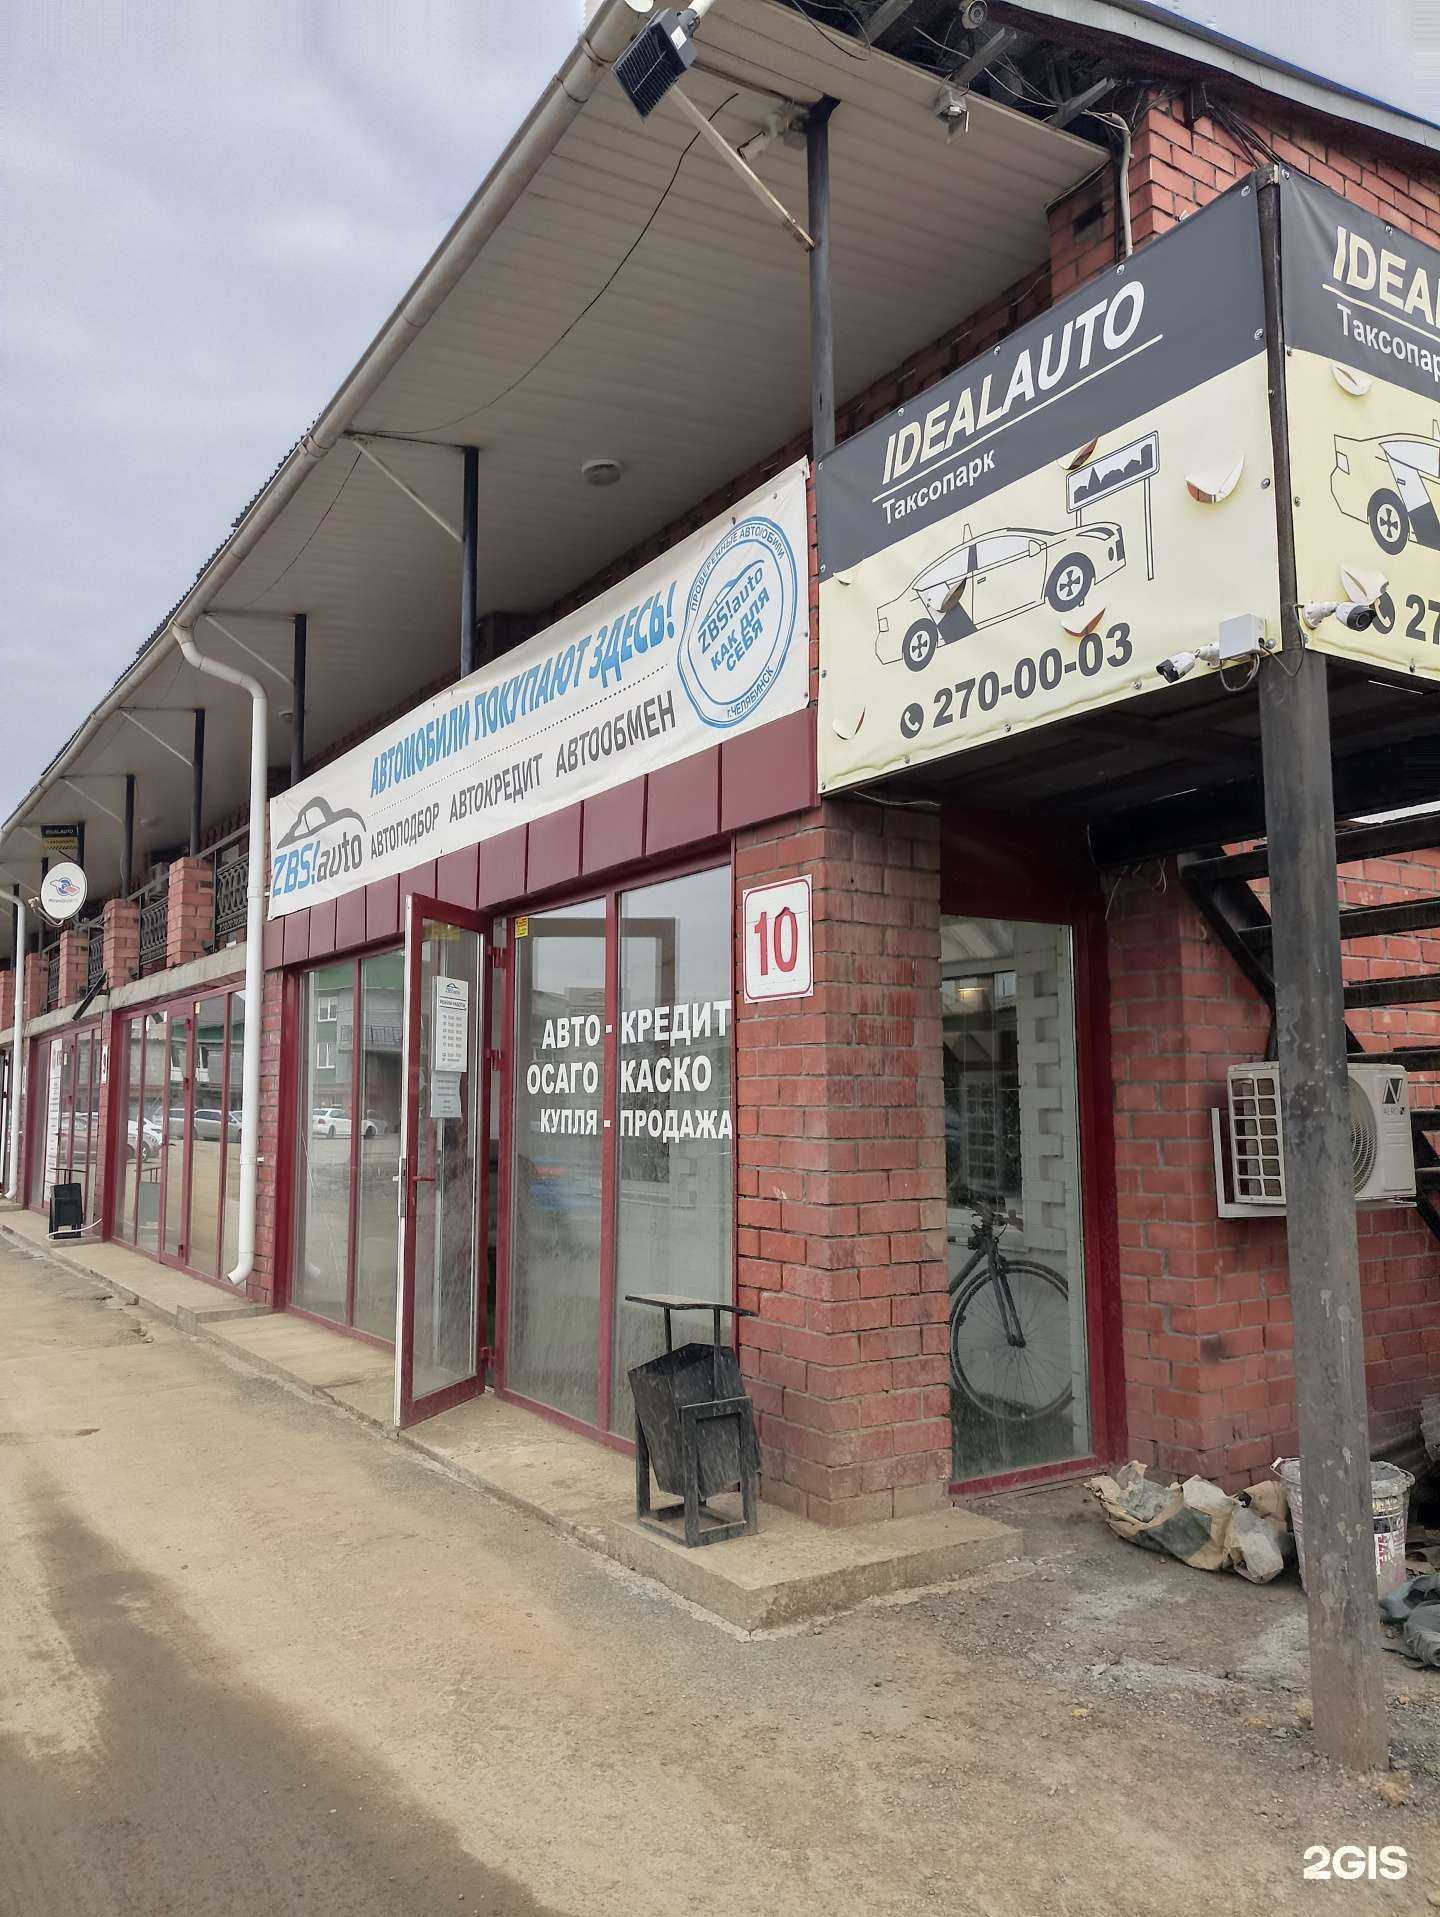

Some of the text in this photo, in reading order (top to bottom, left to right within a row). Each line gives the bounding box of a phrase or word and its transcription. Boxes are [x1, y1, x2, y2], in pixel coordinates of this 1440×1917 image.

[1332, 225, 1440, 329] IDEA
[882, 280, 1145, 485] IDEALAUTO
[882, 449, 997, 524] Таксопарк
[739, 525, 784, 560] АВТООБИЛИ
[697, 566, 764, 655] ZBS!auto
[726, 617, 764, 672] СЕБЯ
[710, 629, 739, 672] КАК
[932, 622, 1133, 728] 270-00-03
[370, 580, 678, 798] АВТОМОБИЛИ ПОКУПАЮТ ЗДЕСЬ!
[370, 690, 676, 860] АВТОПОДБОР АВТОКРЕДИТ АВТООБМЕН
[272, 831, 363, 897] ZBS!auto
[753, 906, 799, 977] 10
[526, 1055, 712, 1095] ОСАГО КАСКО
